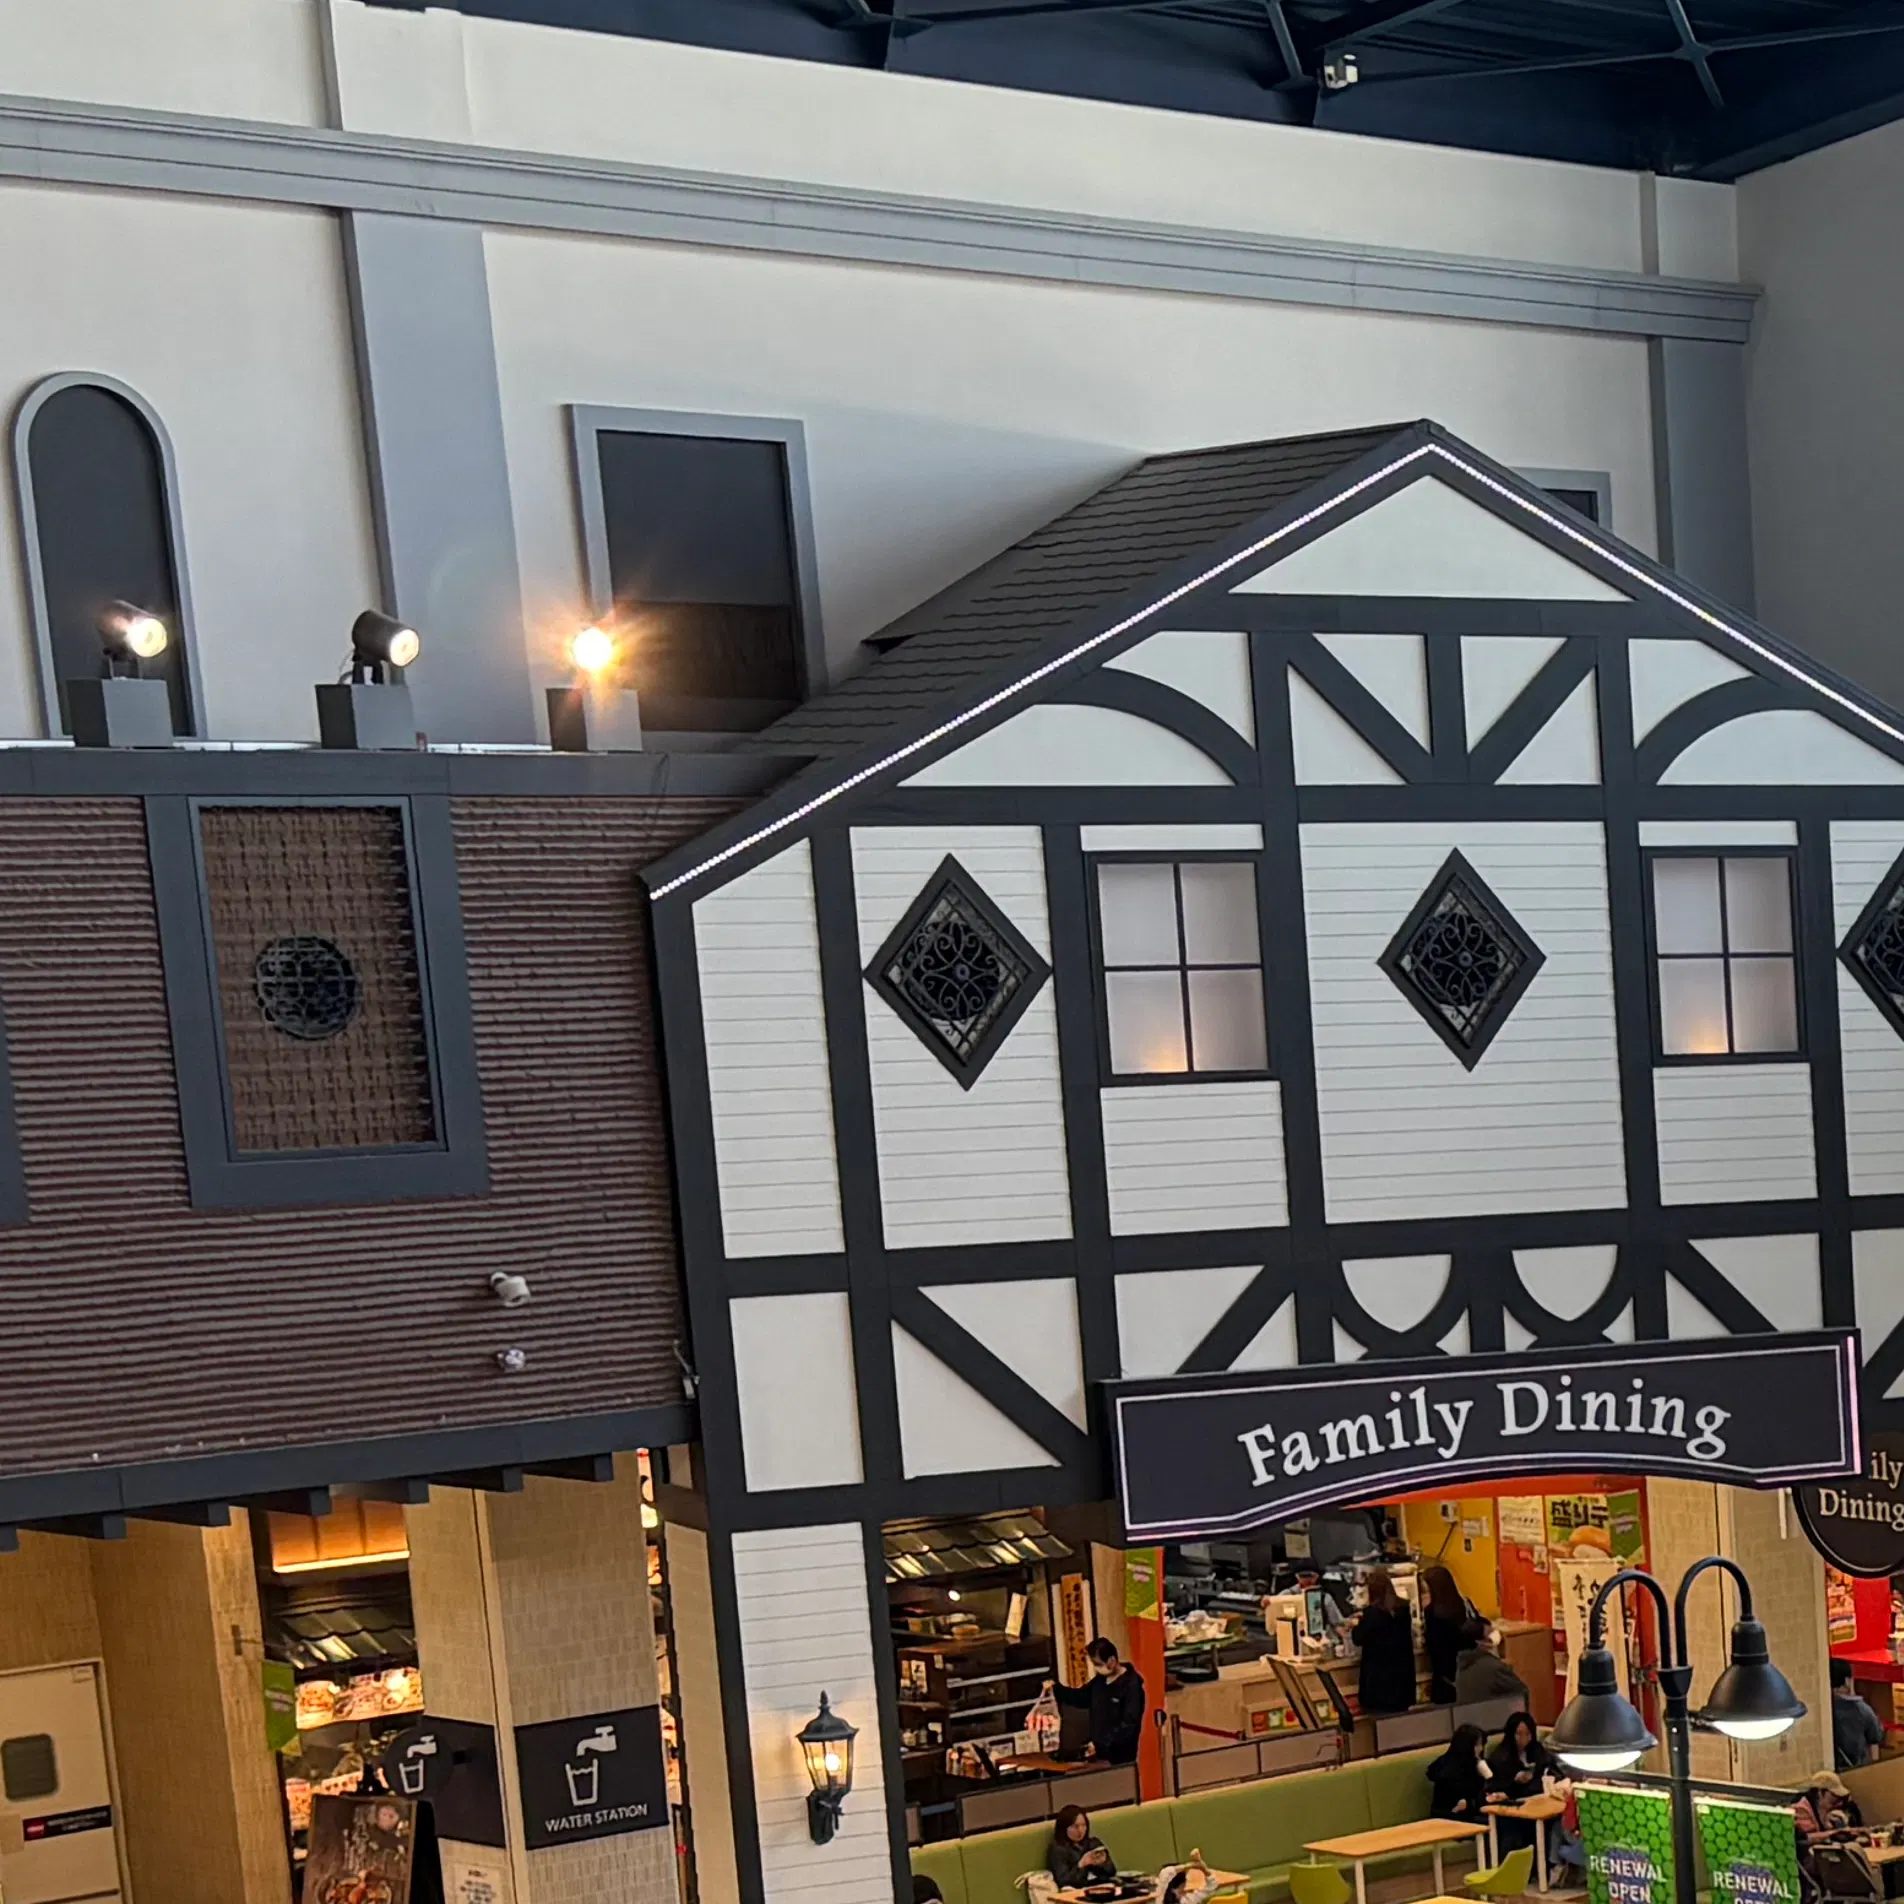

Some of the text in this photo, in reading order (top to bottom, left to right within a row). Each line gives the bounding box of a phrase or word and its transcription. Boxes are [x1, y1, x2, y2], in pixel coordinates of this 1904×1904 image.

[1238, 1374, 1732, 1488] Family Dining
[1868, 1451, 1904, 1490] ily
[544, 1803, 649, 1833] WATER STATION
[1590, 1854, 1668, 1883] RENEWAL
[1608, 1882, 1651, 1904] OPEN
[1713, 1870, 1793, 1900] RENEWAL
